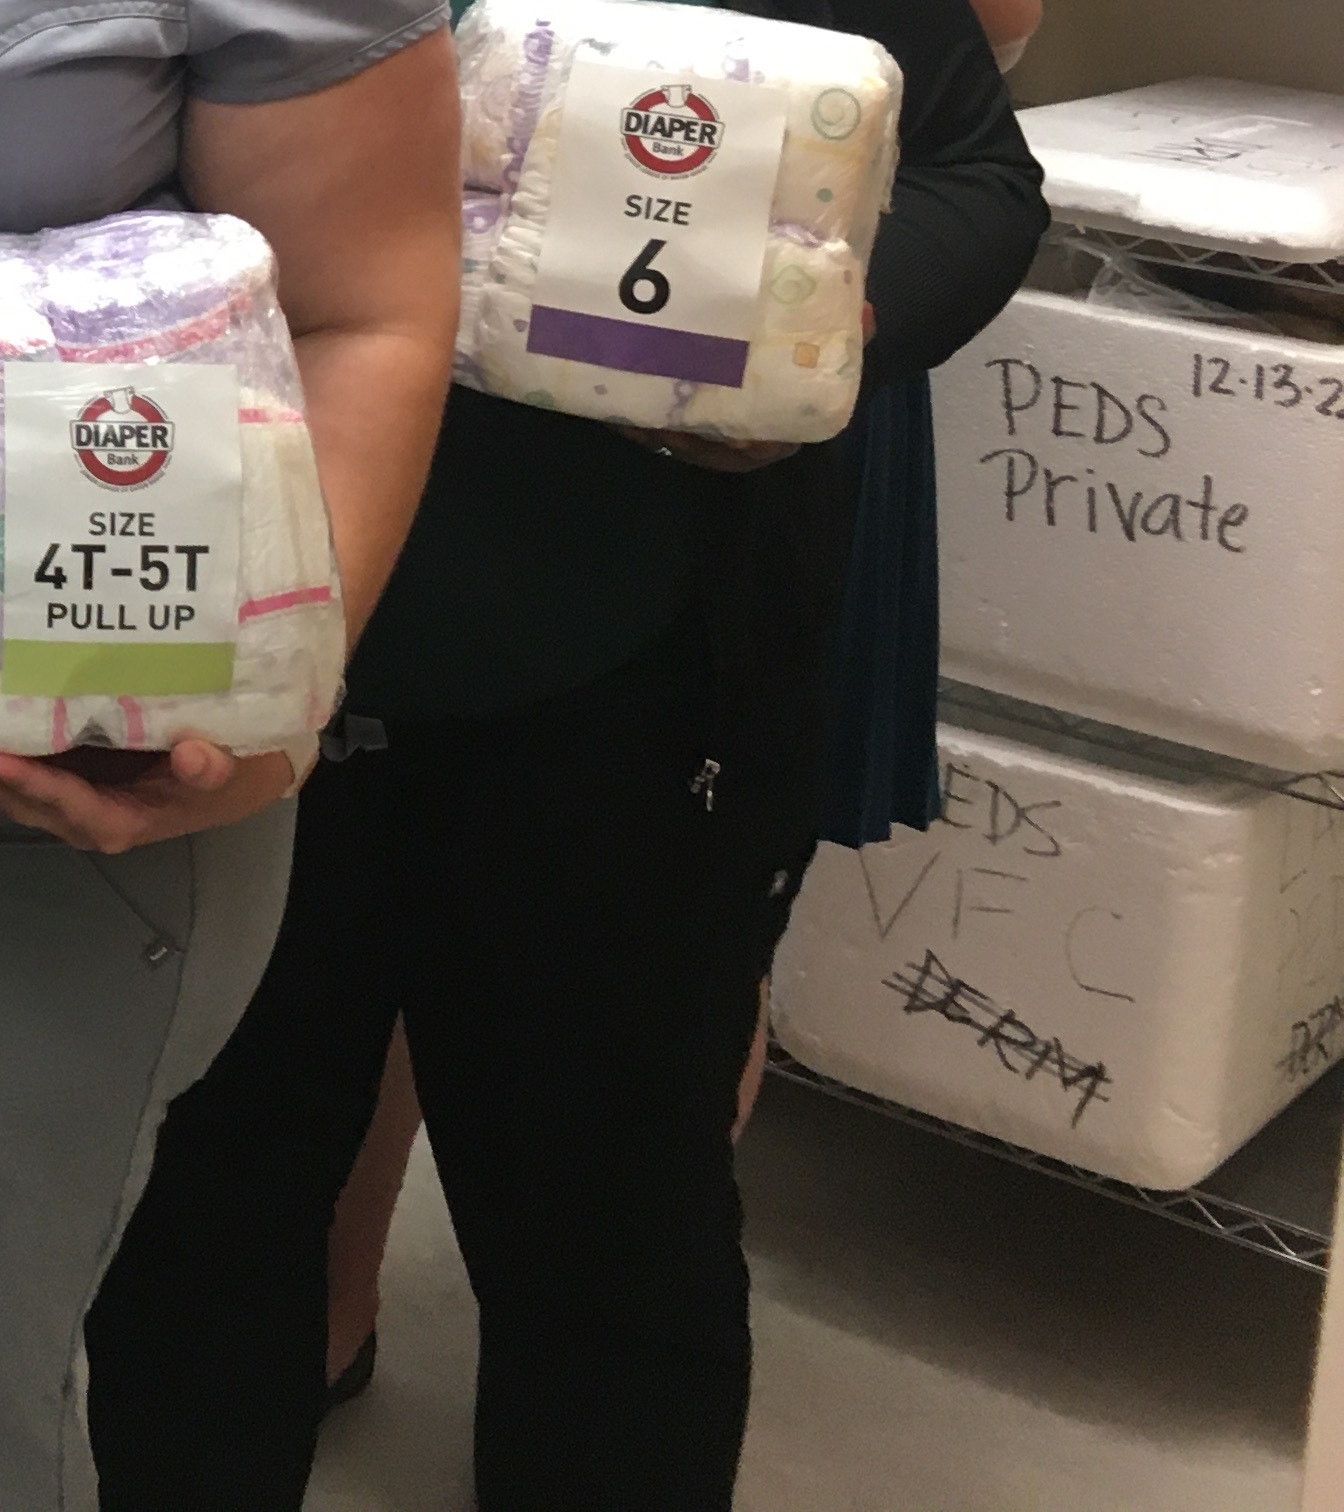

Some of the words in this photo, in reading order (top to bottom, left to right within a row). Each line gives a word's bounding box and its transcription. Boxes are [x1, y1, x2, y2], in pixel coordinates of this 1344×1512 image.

[623, 111, 718, 146] DIAPER
[652, 141, 684, 157] Bank
[623, 194, 692, 226] SIZE
[618, 238, 671, 315] 6
[984, 358, 1172, 458] PEDS
[75, 424, 170, 449] DIAPER
[107, 452, 139, 466] Bank
[979, 448, 1250, 553] Private
[88, 511, 156, 537] SIZE
[34, 543, 210, 592] 4T-5T
[46, 602, 138, 630] PULL
[148, 603, 196, 631] UP
[942, 762, 1063, 857] EDS
